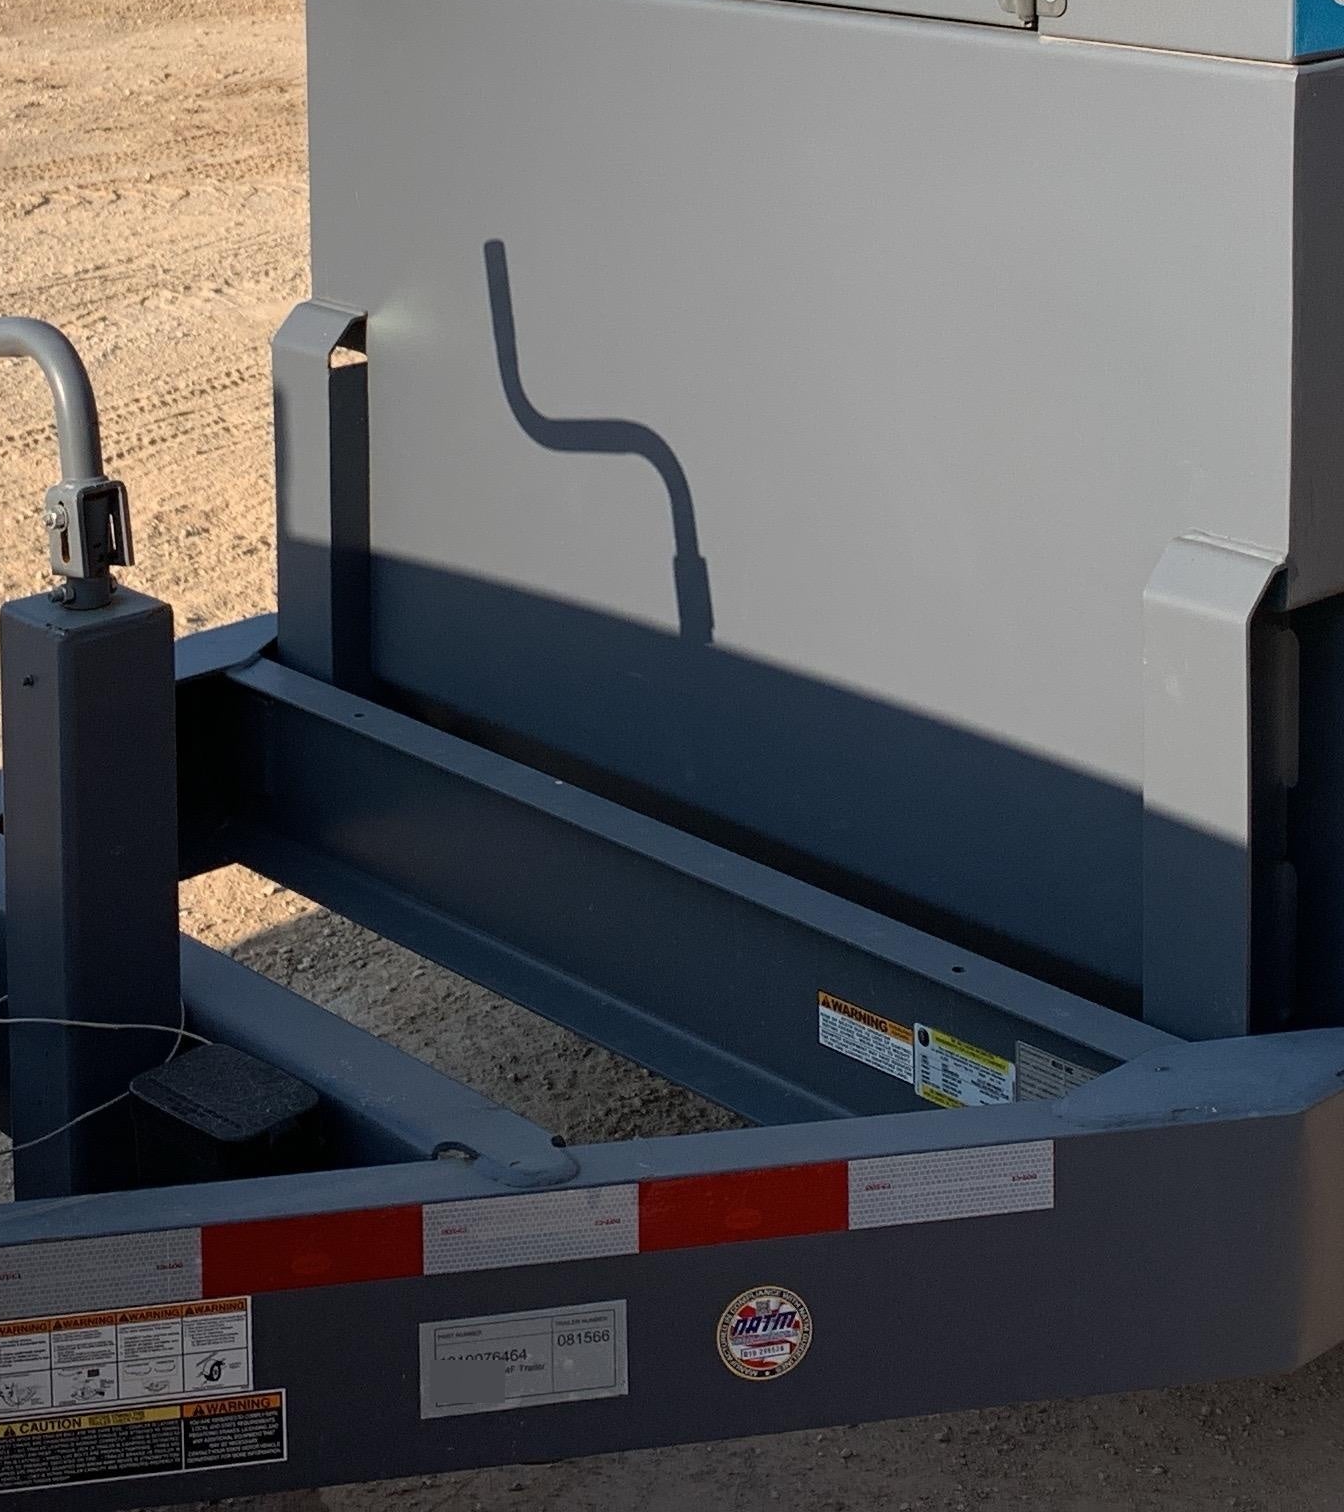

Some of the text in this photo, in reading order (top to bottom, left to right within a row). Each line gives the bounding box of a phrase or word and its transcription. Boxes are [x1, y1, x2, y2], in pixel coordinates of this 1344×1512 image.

[832, 999, 888, 1032] WARNING
[62, 1316, 114, 1329] WARNING
[127, 1308, 181, 1321] WARNING
[193, 1301, 244, 1314] WARNING
[557, 1330, 610, 1347] 081566
[207, 1398, 270, 1413] WARNING
[20, 1418, 82, 1434] CAUTION
